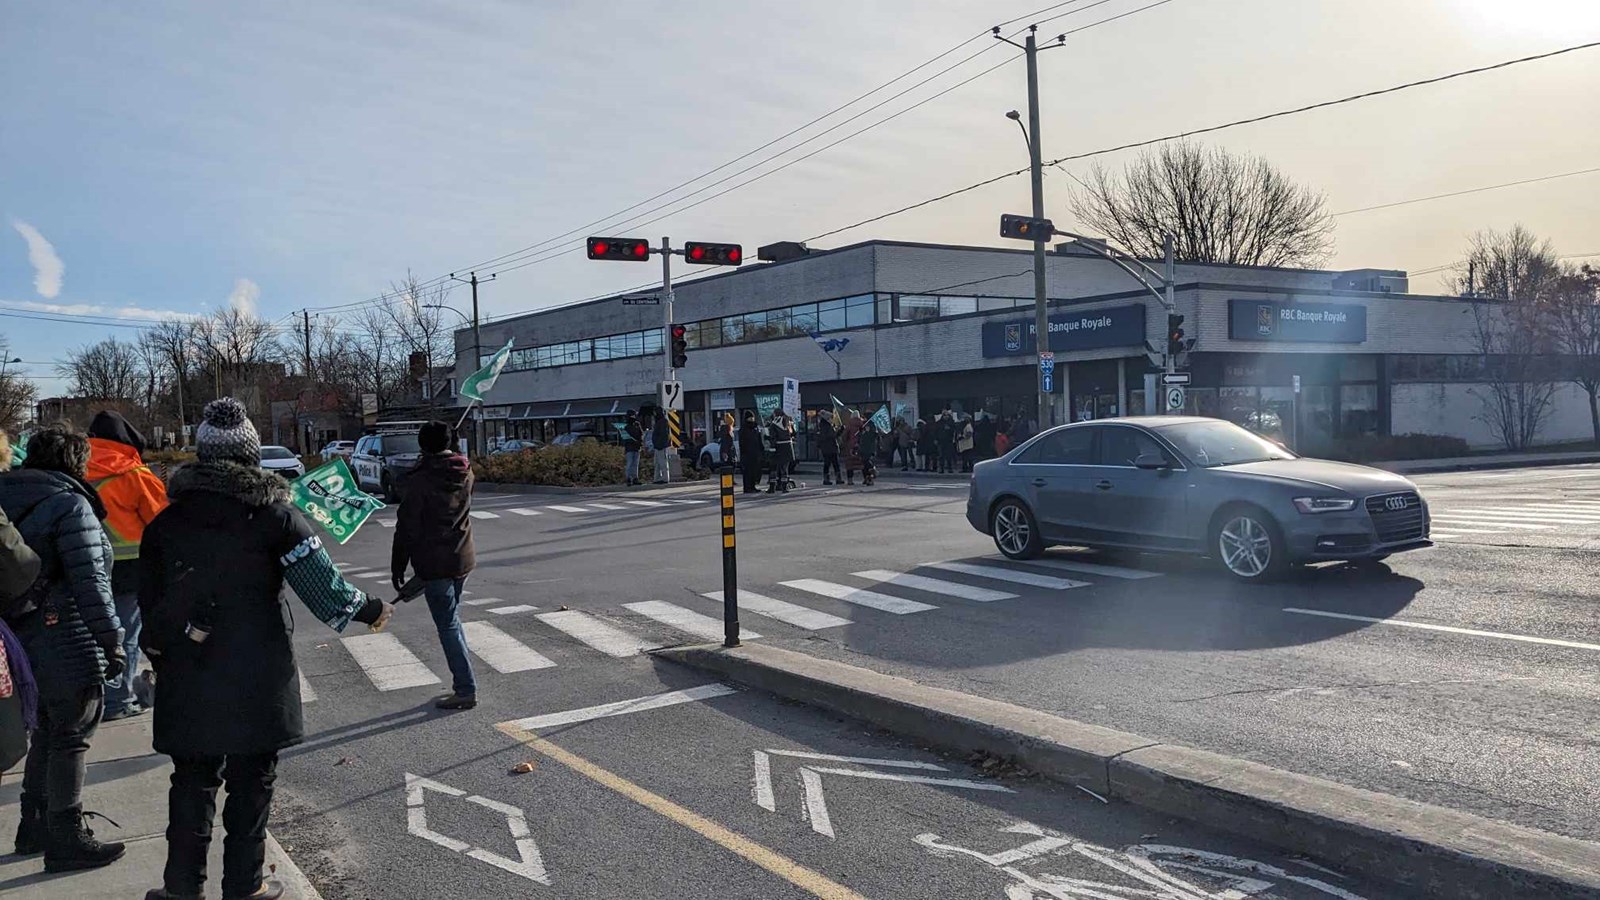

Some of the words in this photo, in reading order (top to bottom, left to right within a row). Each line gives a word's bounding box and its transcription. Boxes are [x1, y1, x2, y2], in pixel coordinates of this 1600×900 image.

[1280, 309, 1295, 320] RBC
[1296, 309, 1322, 323] Banque
[1323, 311, 1347, 324] Royale
[1048, 321, 1079, 333] Banque
[1081, 316, 1112, 331] Royale
[359, 464, 372, 477] Police
